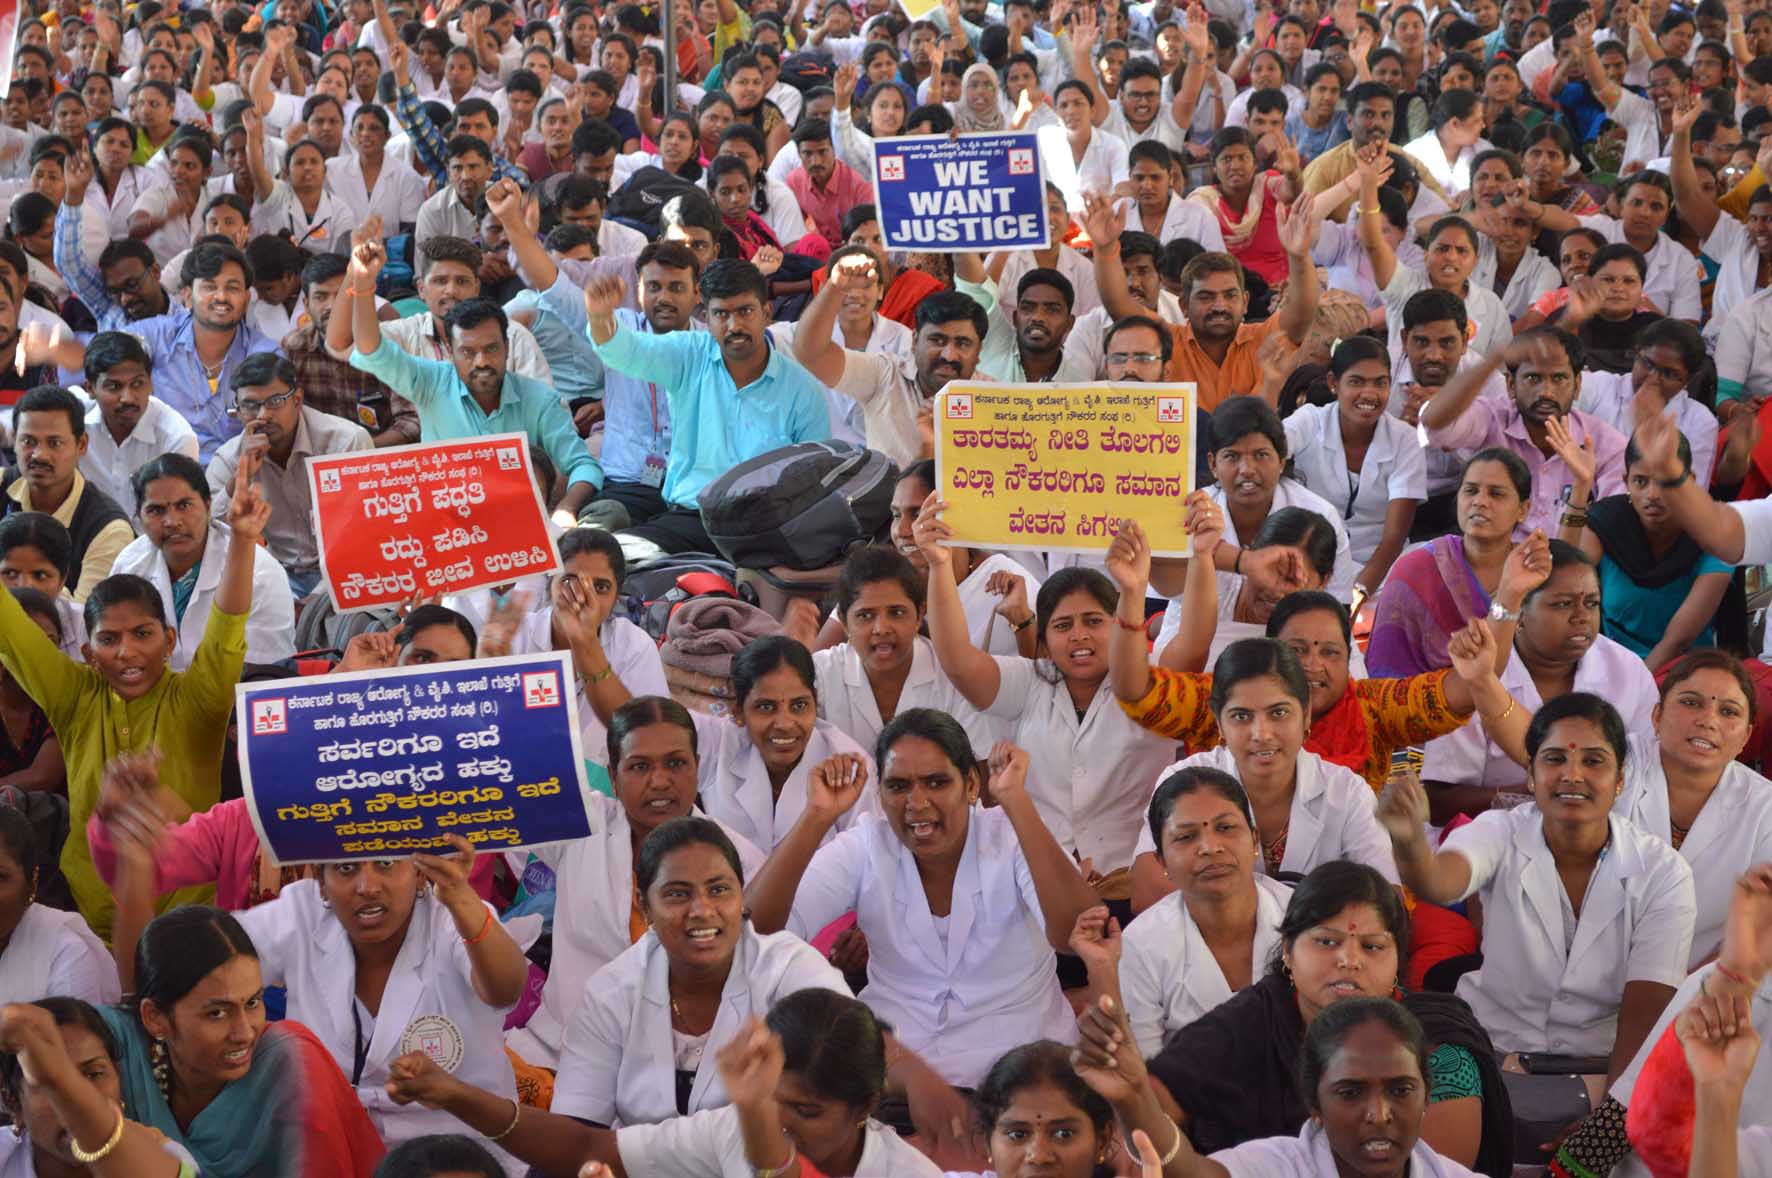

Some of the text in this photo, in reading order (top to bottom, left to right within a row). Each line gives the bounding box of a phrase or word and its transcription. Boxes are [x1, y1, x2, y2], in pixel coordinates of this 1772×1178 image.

[933, 160, 989, 187] WE
[908, 187, 1015, 216] WANT
[891, 214, 1039, 242] JUSTICE
[952, 425, 1181, 462] ತಾರತಮ್ಯ ನೀತಿ ತೊಲಗಲಿ
[952, 462, 1182, 498] ಎಲ್ಲಾ ನೌಕರರಿಗೂ ಸಮಾನ
[363, 480, 486, 524] ಗುತ್ತಿಗೆ ಪದ್ಧತಿ
[1008, 506, 1066, 535] ವೇತನ
[380, 525, 488, 568] ರದ್ದು ಪಡಿಸಿ
[339, 546, 548, 600] ನೌಕರರ ಜೀವ ಉಳಿಸಿ
[287, 692, 334, 710] ಕರ್ನಾಟಕ
[337, 693, 365, 711] ರಾಜ್ಯ
[367, 684, 412, 706] ಆರೋಗ್ಯ
[456, 676, 488, 694] ಇಲಾಖೆ
[491, 673, 520, 693] ಗುತ್ತಿಗೆ
[313, 714, 346, 731] ಹಾಗೂ
[349, 708, 404, 728] ಹೊರಗುತ್ತಿಗೆ
[407, 705, 447, 721] ನೌಕರರ
[450, 702, 476, 718] ಸಂಘ
[317, 724, 500, 763] ಸರ್ವರಿಗೂ ಇದೆ
[315, 755, 514, 792] ಆರೋಗ್ಯದ ಹಕ್ಕು
[276, 777, 560, 822] ಗುತ್ತಿಗೆ ನೌಕರರಿಗೂ ಇದೆ
[335, 806, 515, 836] ಸಮಾನ ವೇತನ
[466, 827, 522, 845] ಹಕ್ಕು
